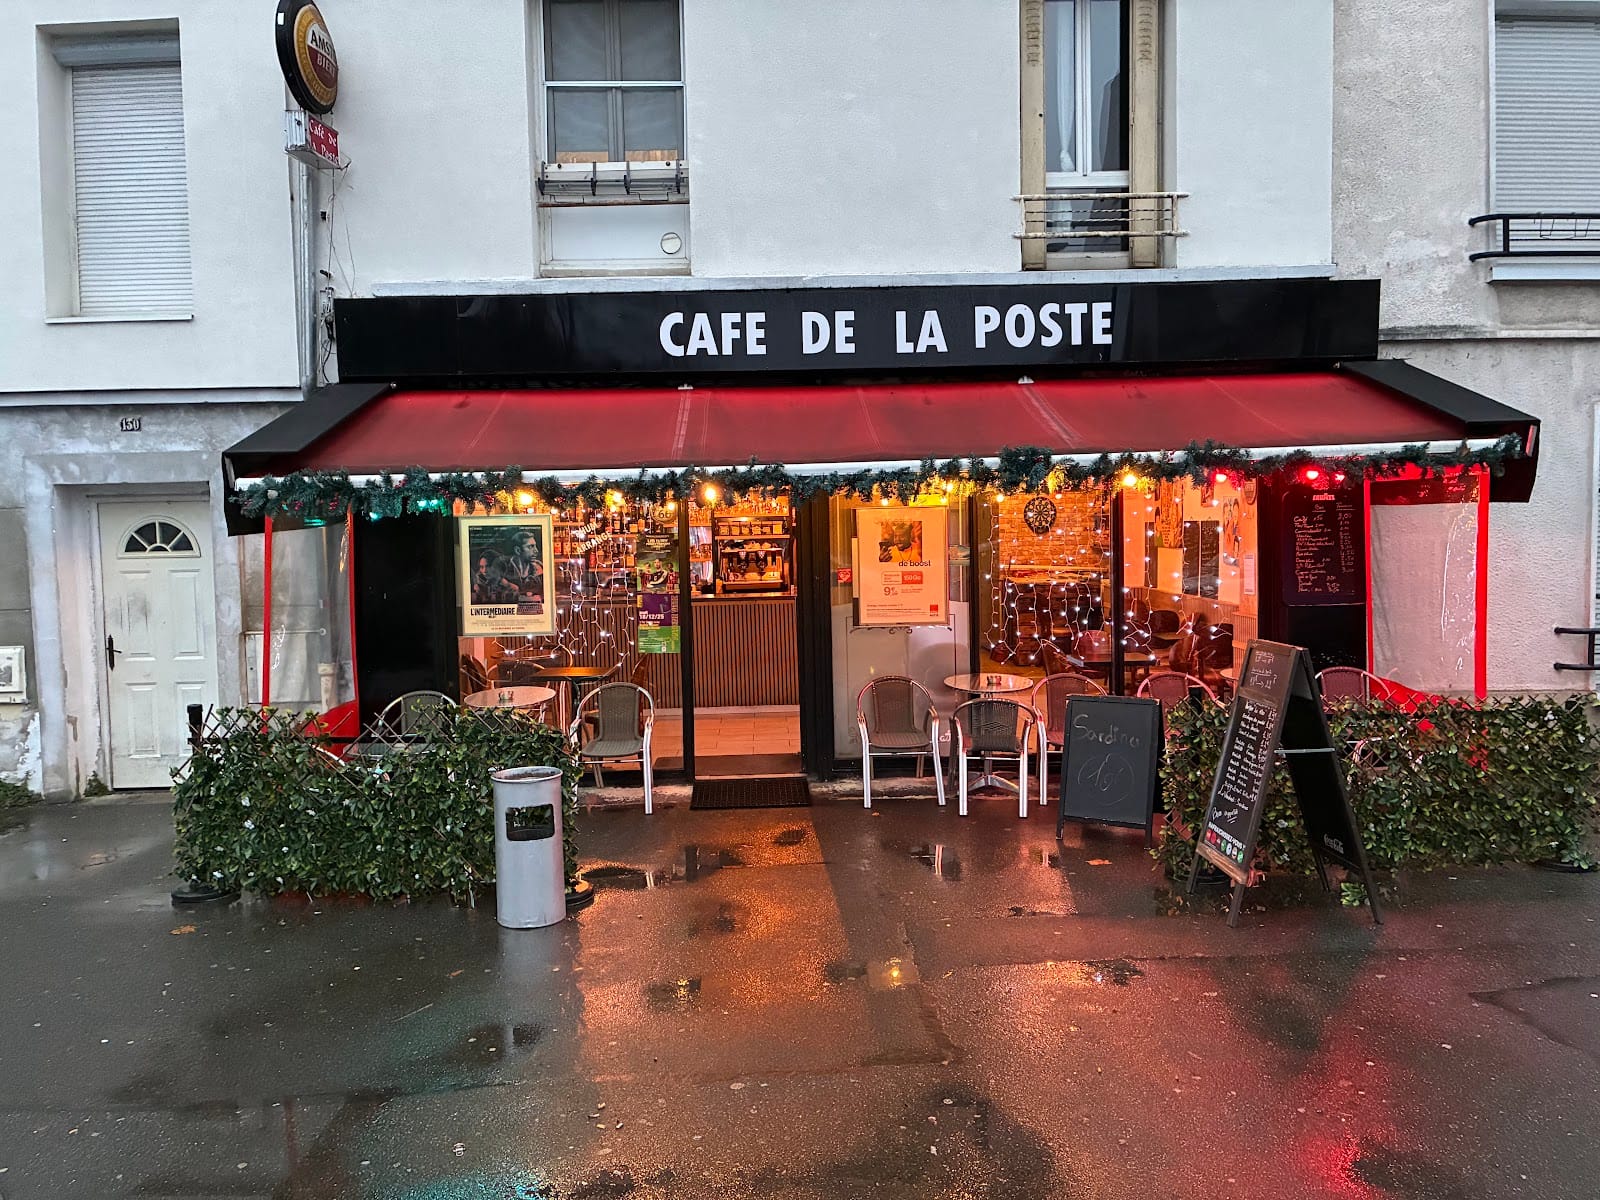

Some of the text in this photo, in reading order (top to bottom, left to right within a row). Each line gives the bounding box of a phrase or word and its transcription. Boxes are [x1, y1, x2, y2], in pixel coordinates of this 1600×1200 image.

[659, 301, 1113, 357] CAFE DE LA POSTE
